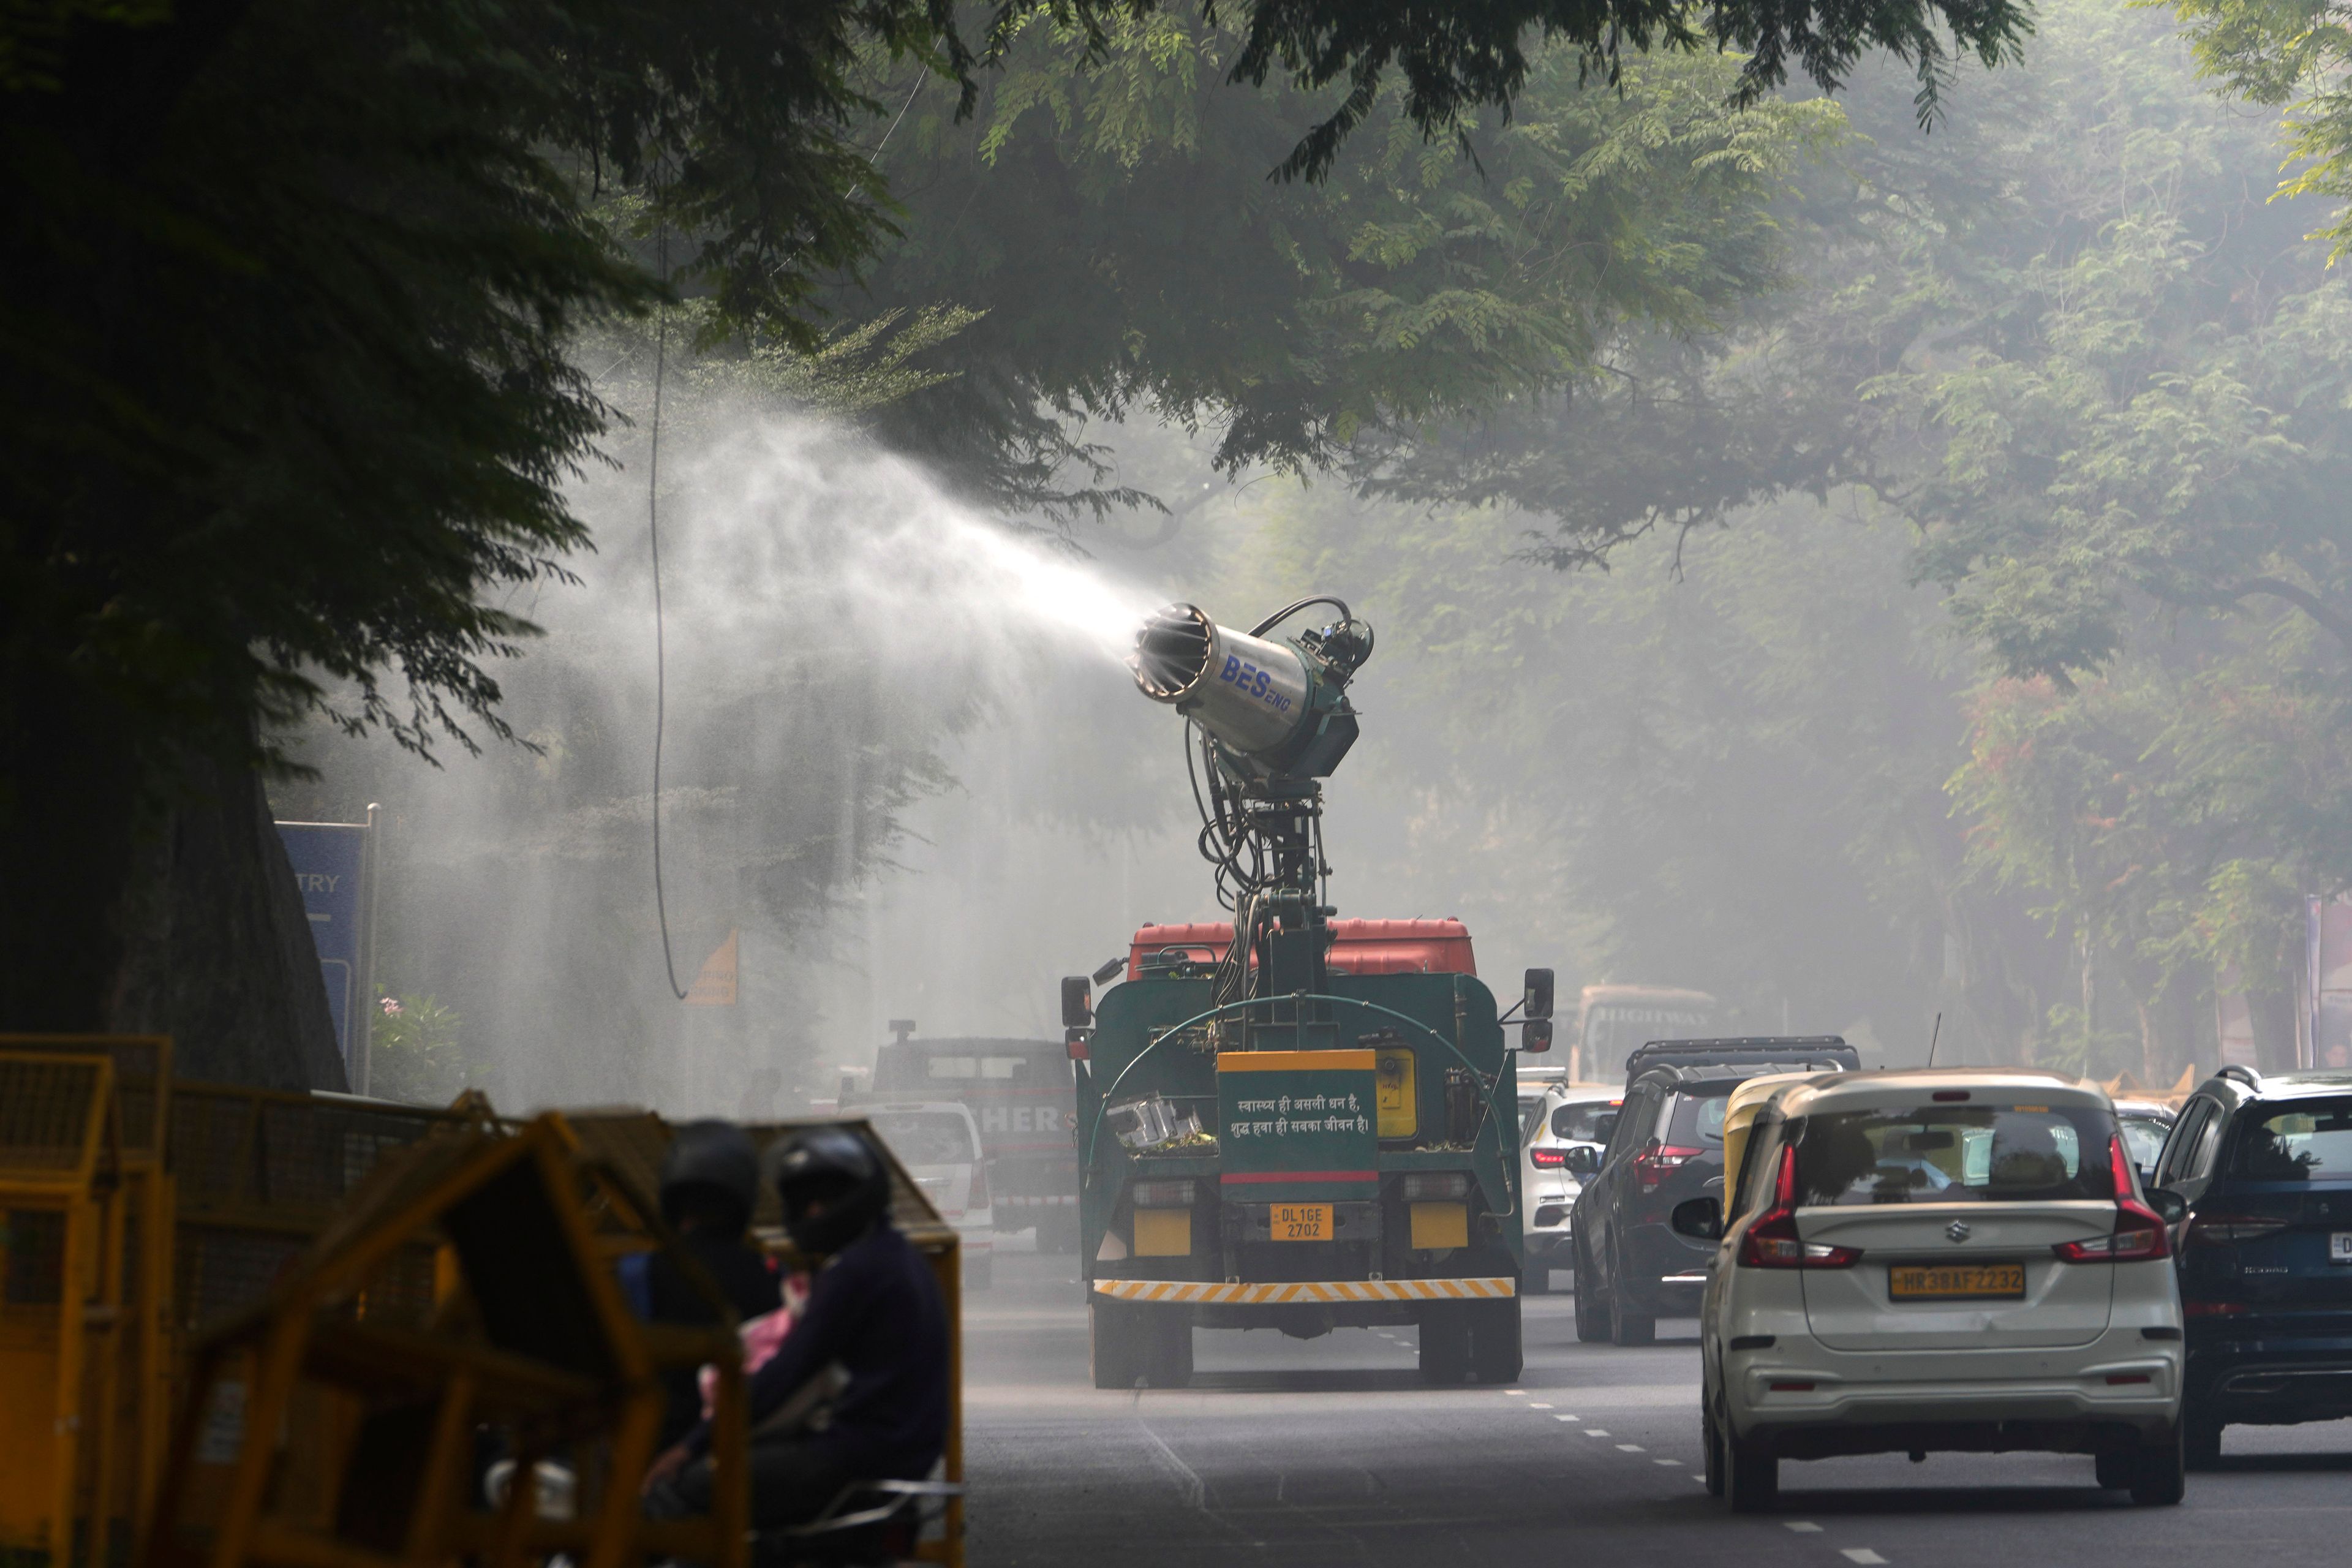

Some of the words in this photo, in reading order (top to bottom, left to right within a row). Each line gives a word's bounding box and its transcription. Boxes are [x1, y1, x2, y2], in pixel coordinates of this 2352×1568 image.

[1220, 654, 1271, 698] BES
[1600, 1007, 1708, 1025] HIGHWAY
[1278, 1095, 1291, 1115] ही
[1294, 1094, 1326, 1111] असली
[1329, 1097, 1346, 1110] धन
[1348, 1093, 1360, 1113] है,
[1231, 1121, 1250, 1139] शुद्ध
[1253, 1121, 1273, 1137] हवा
[1275, 1117, 1289, 1137] ही
[1291, 1120, 1322, 1133] सबका
[1324, 1115, 1354, 1132] जीवन
[1287, 1223, 1319, 1237] 2702
